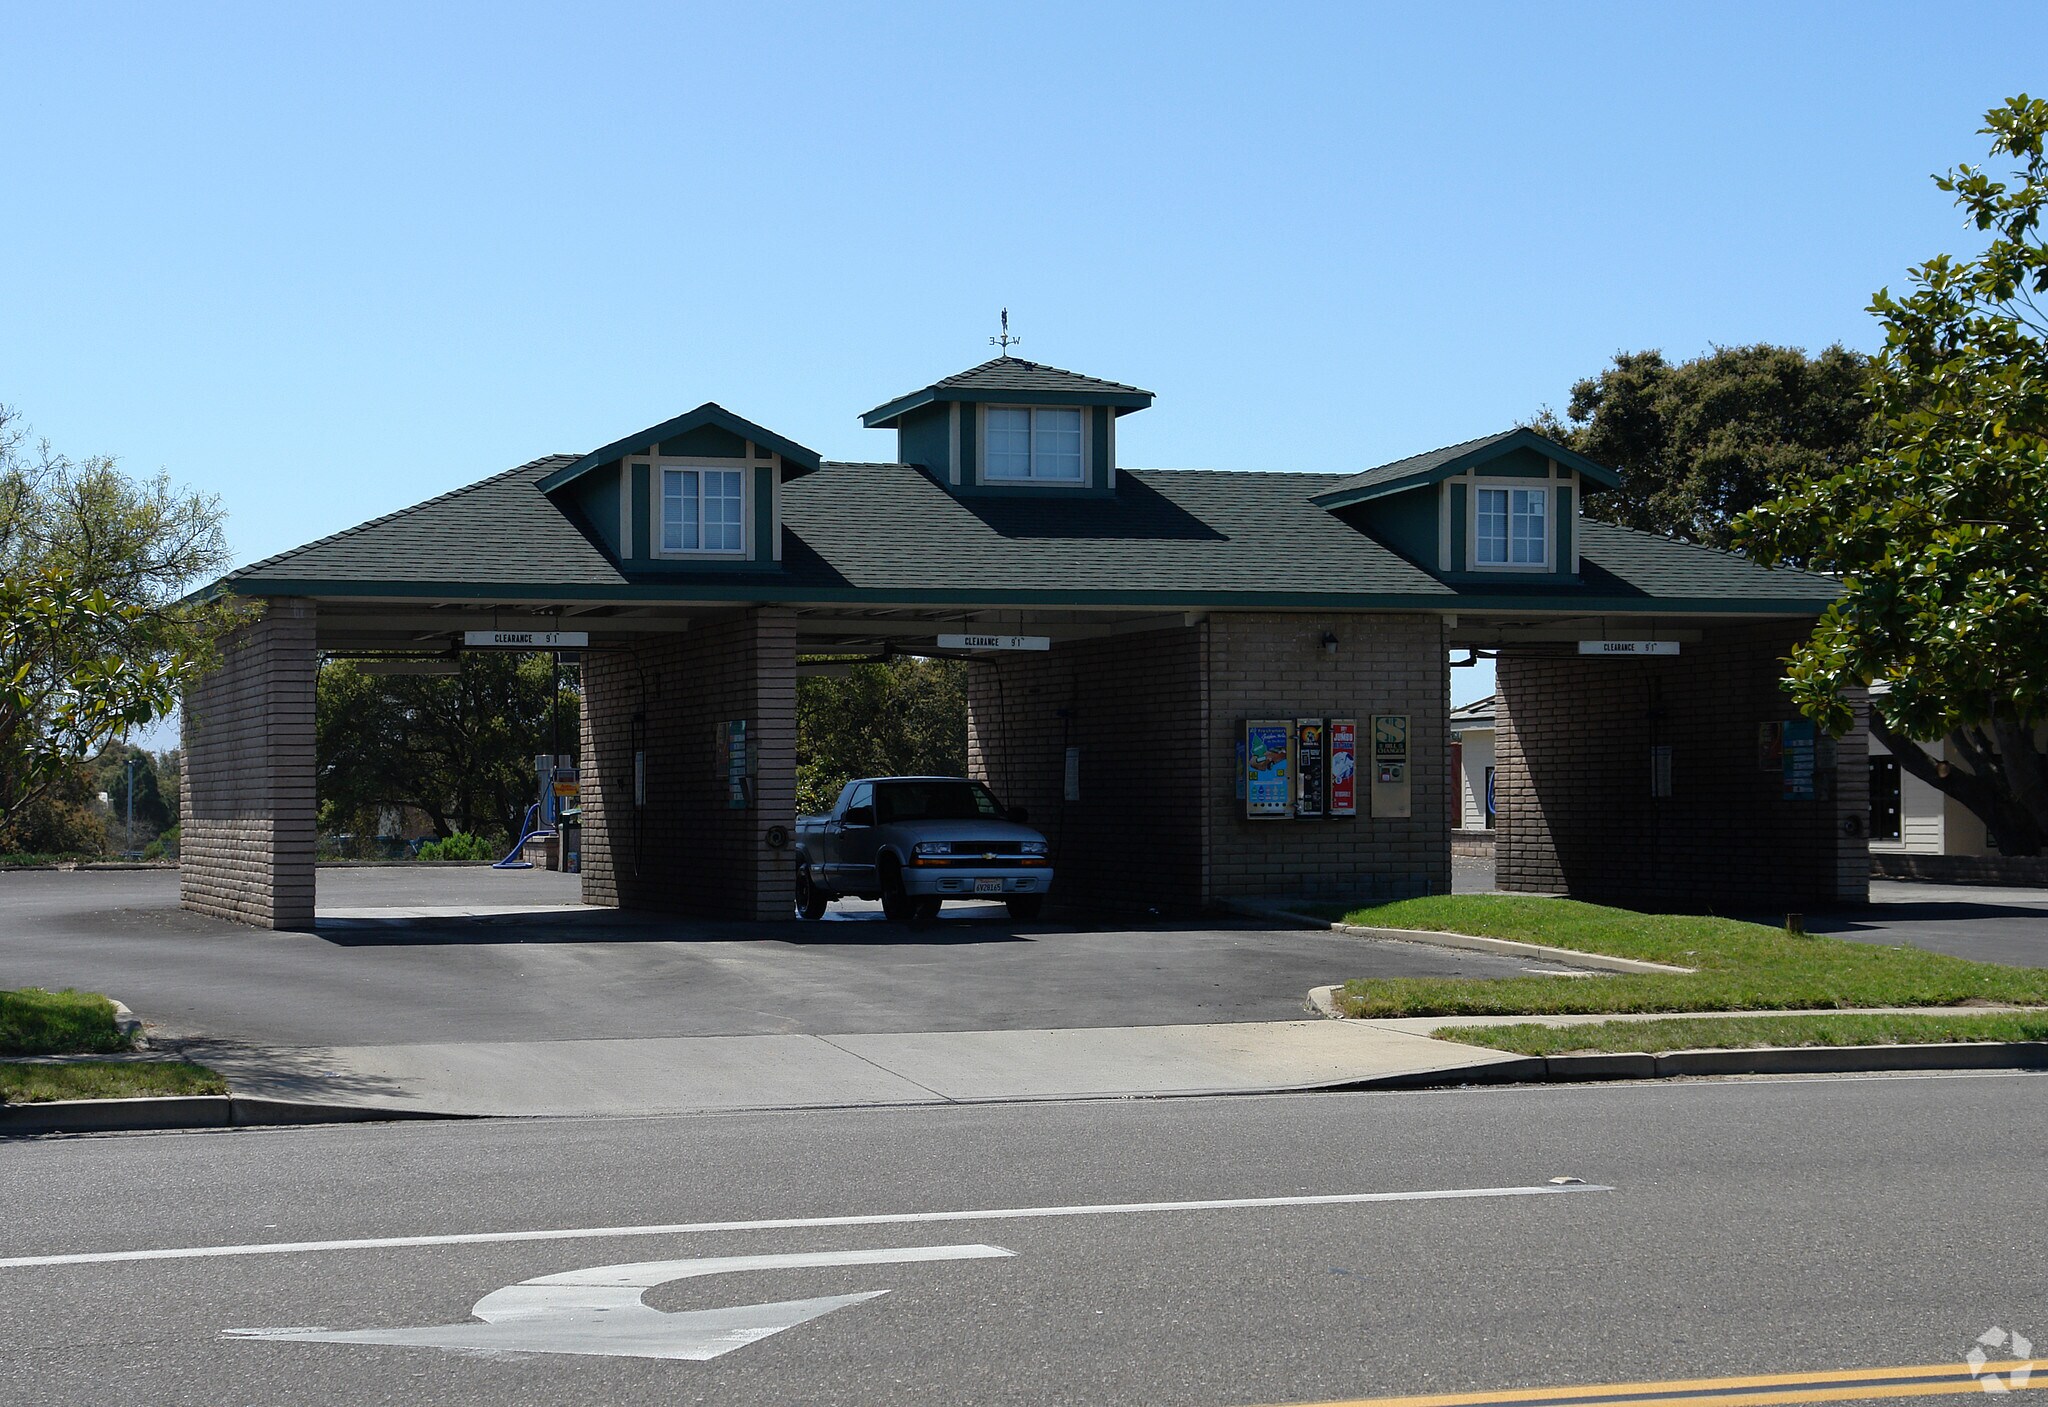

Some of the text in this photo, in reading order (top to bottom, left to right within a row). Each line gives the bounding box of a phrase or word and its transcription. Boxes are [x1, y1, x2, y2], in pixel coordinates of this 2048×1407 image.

[494, 634, 533, 643] CLEARANCE
[964, 637, 999, 647] CLEARANCE
[1603, 643, 1635, 652] CLEARANCE
[1334, 733, 1353, 741] JUMBO
